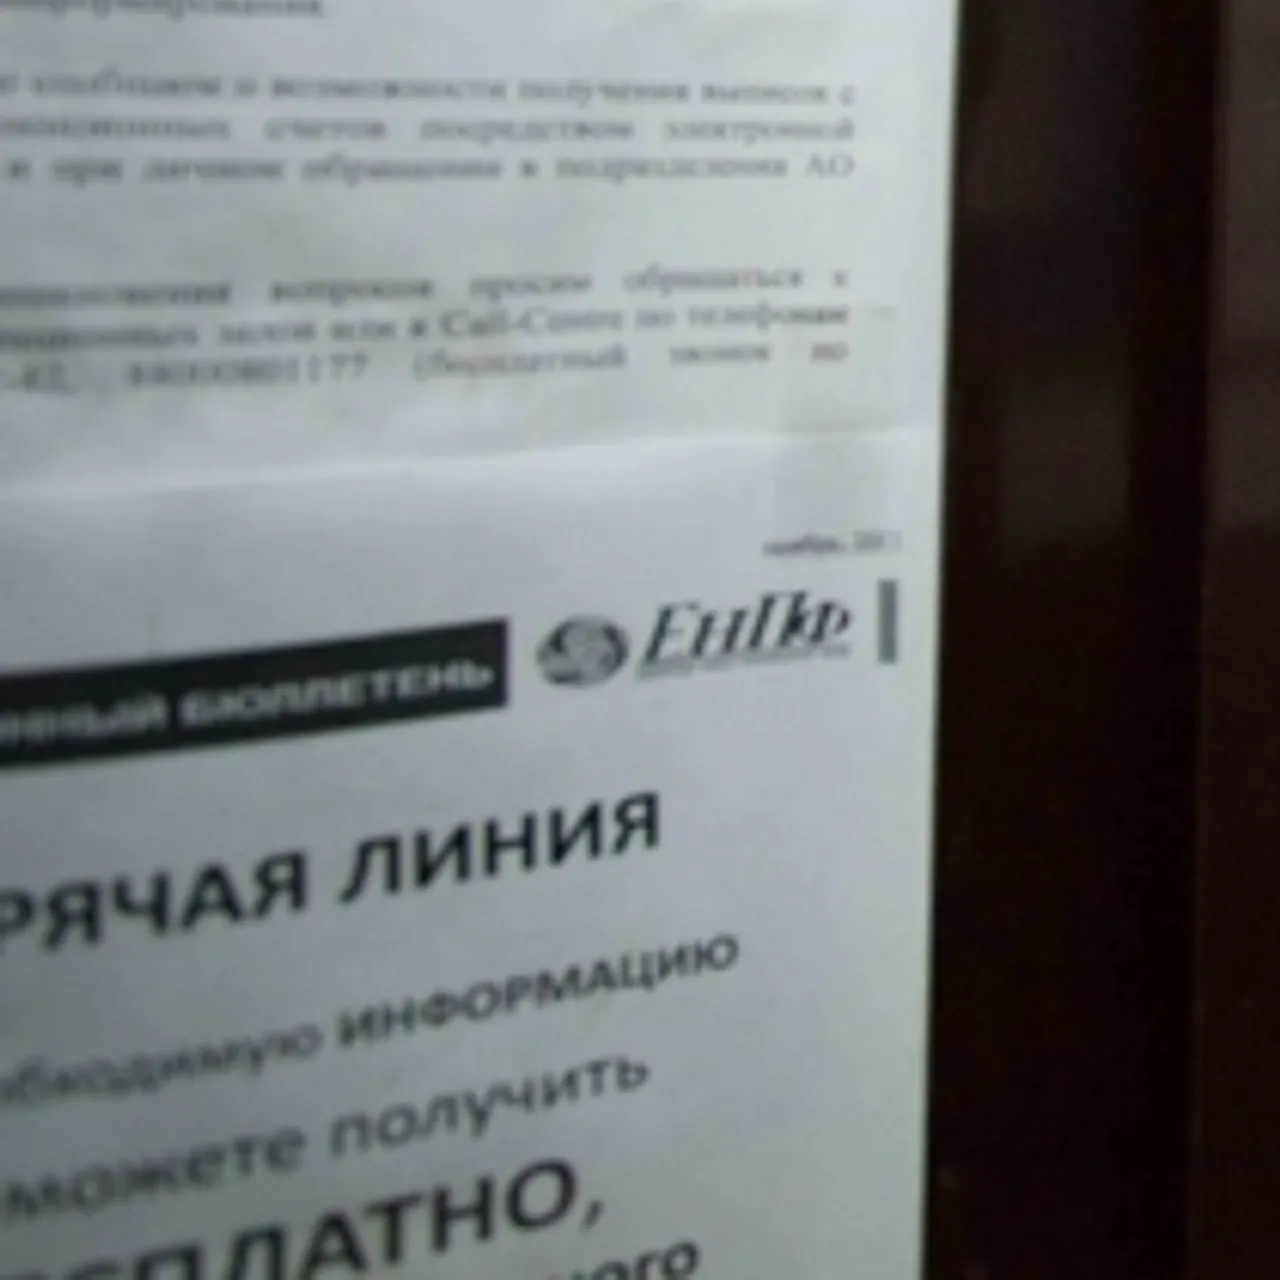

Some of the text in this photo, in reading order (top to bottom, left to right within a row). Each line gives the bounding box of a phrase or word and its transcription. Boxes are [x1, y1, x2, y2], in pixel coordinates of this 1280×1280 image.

[338, 790, 661, 907] ЛИНИЯ
[336, 932, 741, 1048] ИНФОРМАЦИЮ
[328, 1055, 653, 1160] получить
